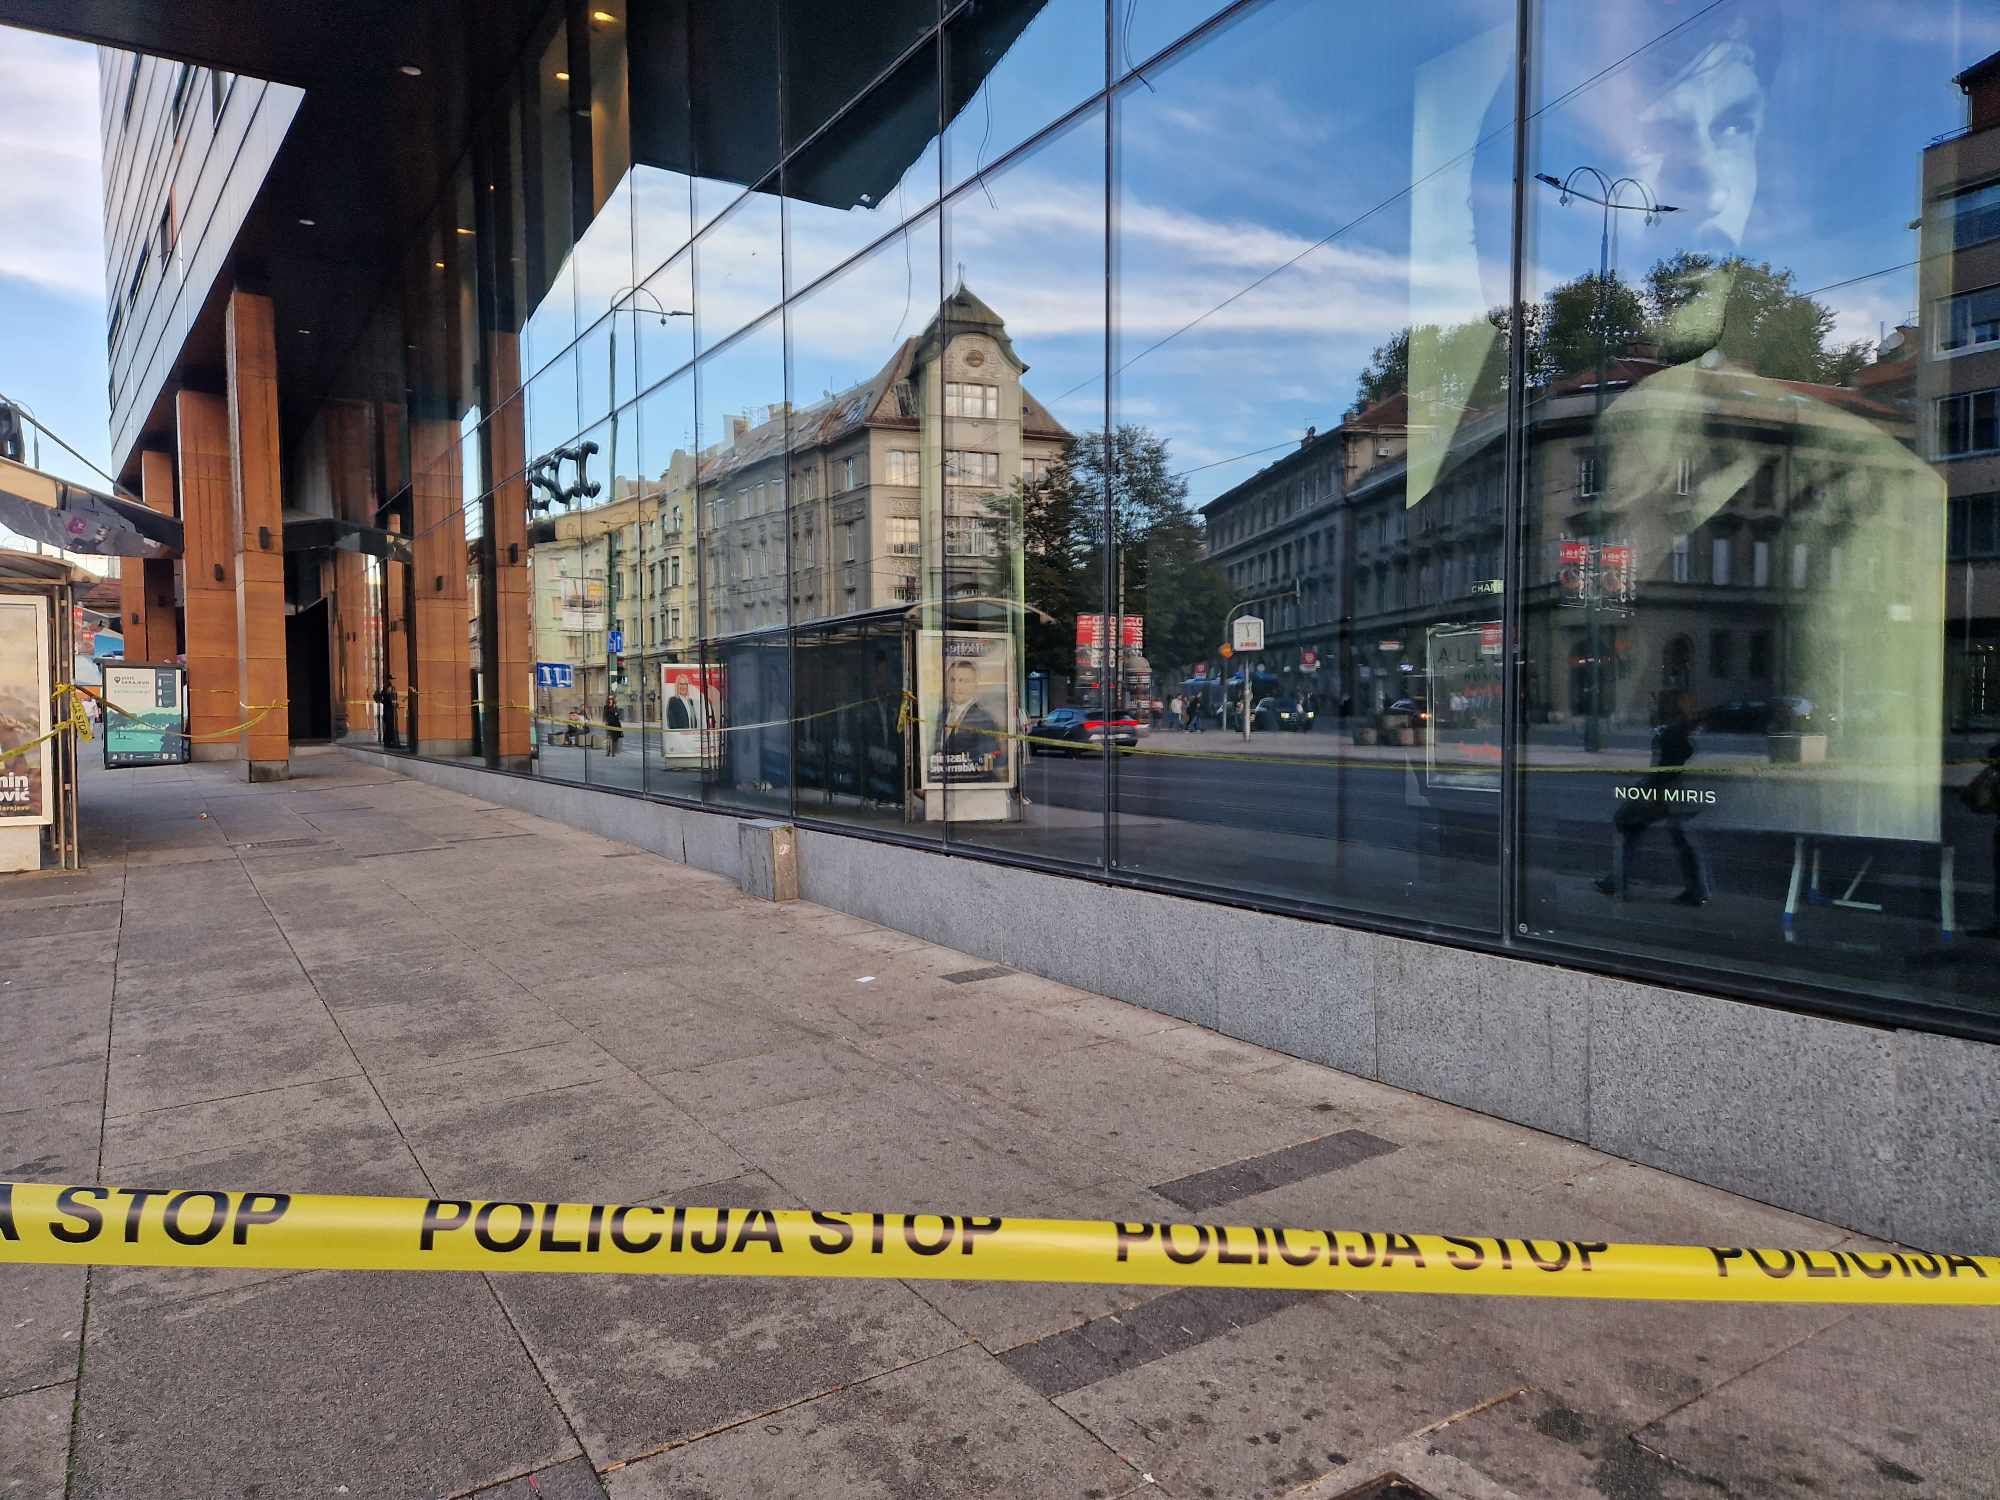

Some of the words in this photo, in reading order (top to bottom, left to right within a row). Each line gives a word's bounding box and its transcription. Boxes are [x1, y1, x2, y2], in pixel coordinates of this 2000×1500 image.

[1471, 581, 1504, 594] CHANE
[1615, 786, 1657, 801] NOVI
[1664, 788, 1717, 804] MIRIS
[48, 1186, 292, 1246] STOP
[418, 1199, 783, 1254] POLICIJA
[809, 1210, 1002, 1256] STOP
[1114, 1221, 1427, 1268] POLICIJA
[1441, 1234, 1609, 1272] STOP
[1706, 1246, 1989, 1279] POLICIJA
